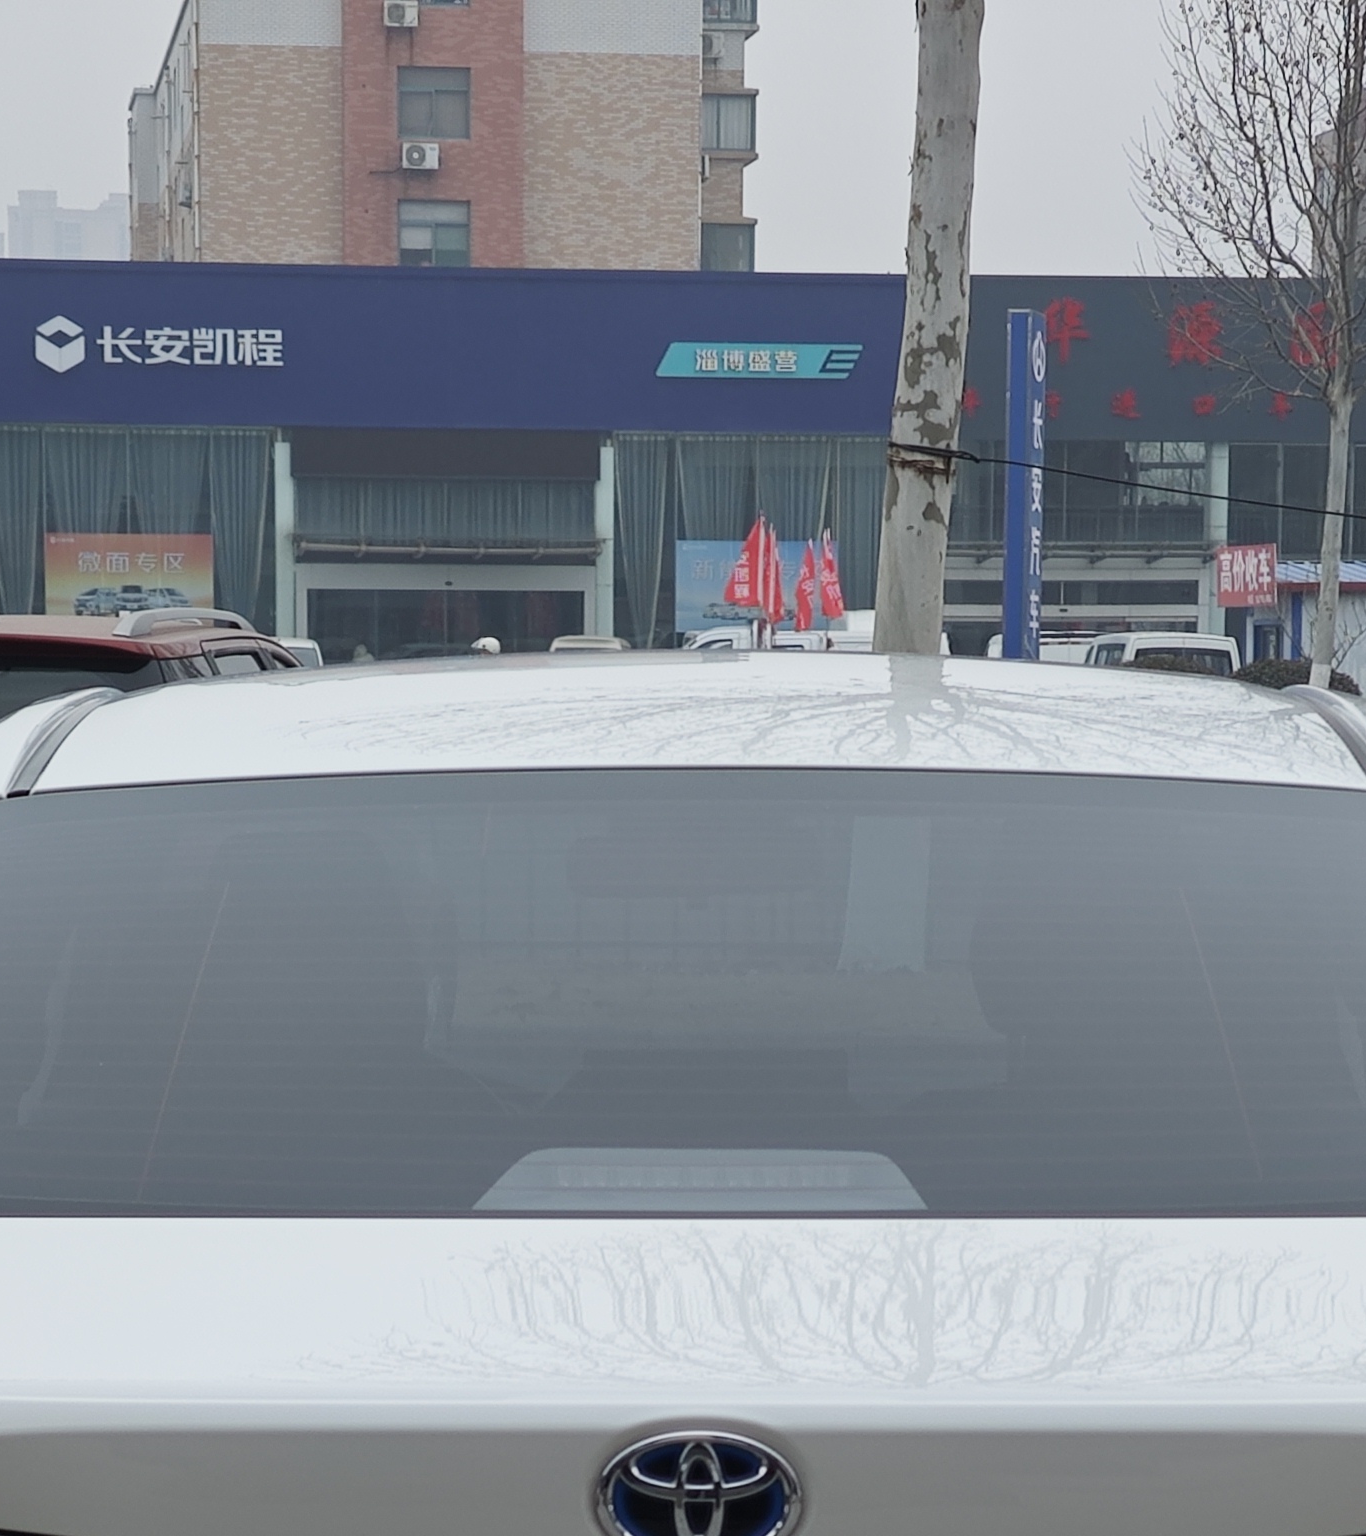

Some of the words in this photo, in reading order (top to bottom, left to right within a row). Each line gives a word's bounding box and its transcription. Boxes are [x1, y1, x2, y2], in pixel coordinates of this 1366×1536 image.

[96, 325, 284, 366] 长安凯程
[695, 350, 798, 372] 淄博盛营
[78, 551, 184, 573] 微面专区
[1219, 549, 1272, 593] 高价收车
